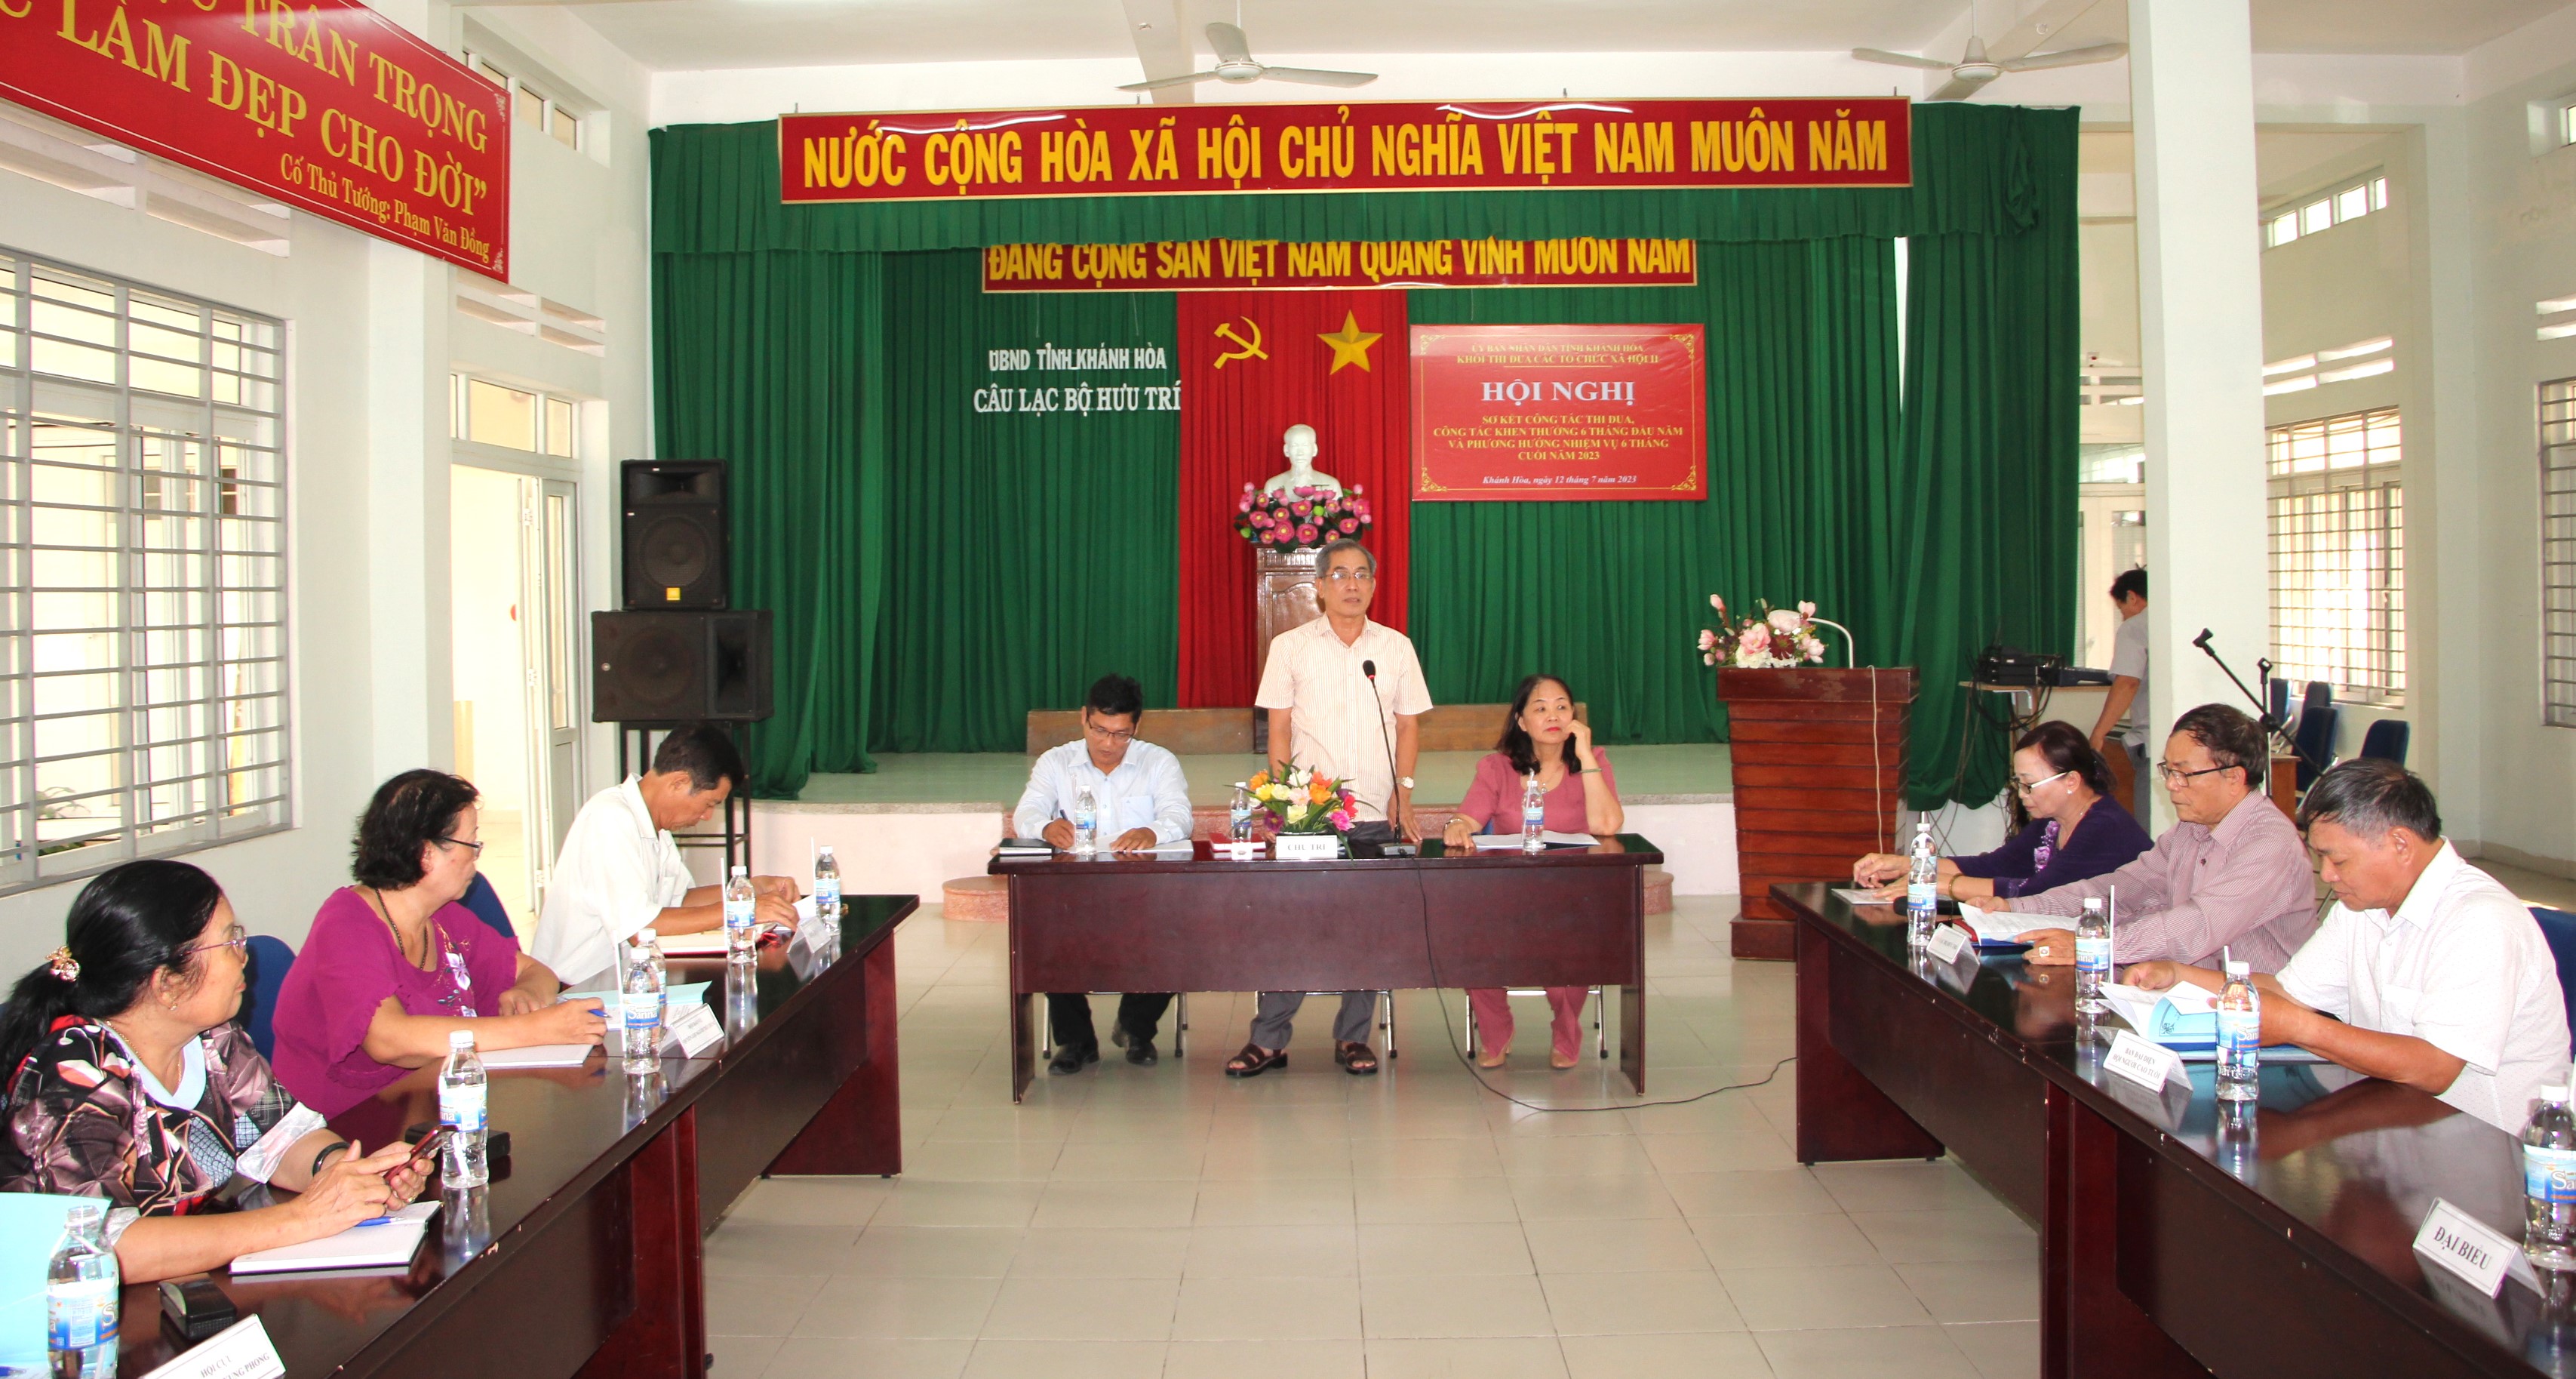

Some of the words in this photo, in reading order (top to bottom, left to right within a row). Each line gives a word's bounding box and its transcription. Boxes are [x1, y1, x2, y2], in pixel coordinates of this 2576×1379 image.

[369, 51, 488, 153] TRỌNG
[207, 50, 307, 139] ĐẸP
[321, 108, 404, 183] CHO
[804, 119, 906, 188] NƯỚC
[924, 119, 1022, 195] CỘNG
[1041, 119, 1113, 183] HÒA
[1128, 115, 1179, 180] XÃ
[1197, 114, 1262, 189] HỘI
[1278, 105, 1354, 178] CHỦ
[1372, 112, 1484, 176] NGHĨA
[1497, 109, 1578, 184] VIỆT
[1594, 122, 1675, 174] NAM
[1691, 107, 1794, 173] MUÔN
[1809, 109, 1886, 171] NĂM
[281, 153, 304, 185] Cố
[307, 163, 338, 199] Thủ
[394, 199, 431, 236] Phạm
[434, 215, 456, 246] Văn
[460, 226, 490, 263] Đồng
[1288, 241, 1351, 277] NAM
[1360, 239, 1452, 282] QUANG
[988, 349, 1031, 371] UBND
[1077, 342, 1130, 369] KHÁNH
[1134, 342, 1167, 369] HÒA
[973, 383, 1013, 412] CÂU
[1019, 387, 1059, 417] LẠC
[1065, 381, 1091, 417] BỘ
[1096, 383, 1139, 411] HƯU
[1145, 380, 1182, 411] TRÍ
[1480, 379, 1543, 406] HỘI
[1551, 381, 1636, 405] NGHỊ
[1434, 426, 1466, 436] CÔNG
[1469, 426, 1492, 436] TÁC
[1495, 427, 1526, 436] KHEN
[1581, 427, 1587, 436] 6
[1589, 425, 1628, 436] THÁNG
[1525, 413, 1558, 424] CÔNG
[1586, 415, 1606, 423] THI
[1578, 451, 1600, 460] 2023
[1622, 439, 1627, 448] 6
[1629, 437, 1669, 448] THÁNG
[1483, 476, 1509, 484] Khánh
[1566, 476, 1589, 485] tháng
[2433, 1225, 2460, 1251] ĐẠI
